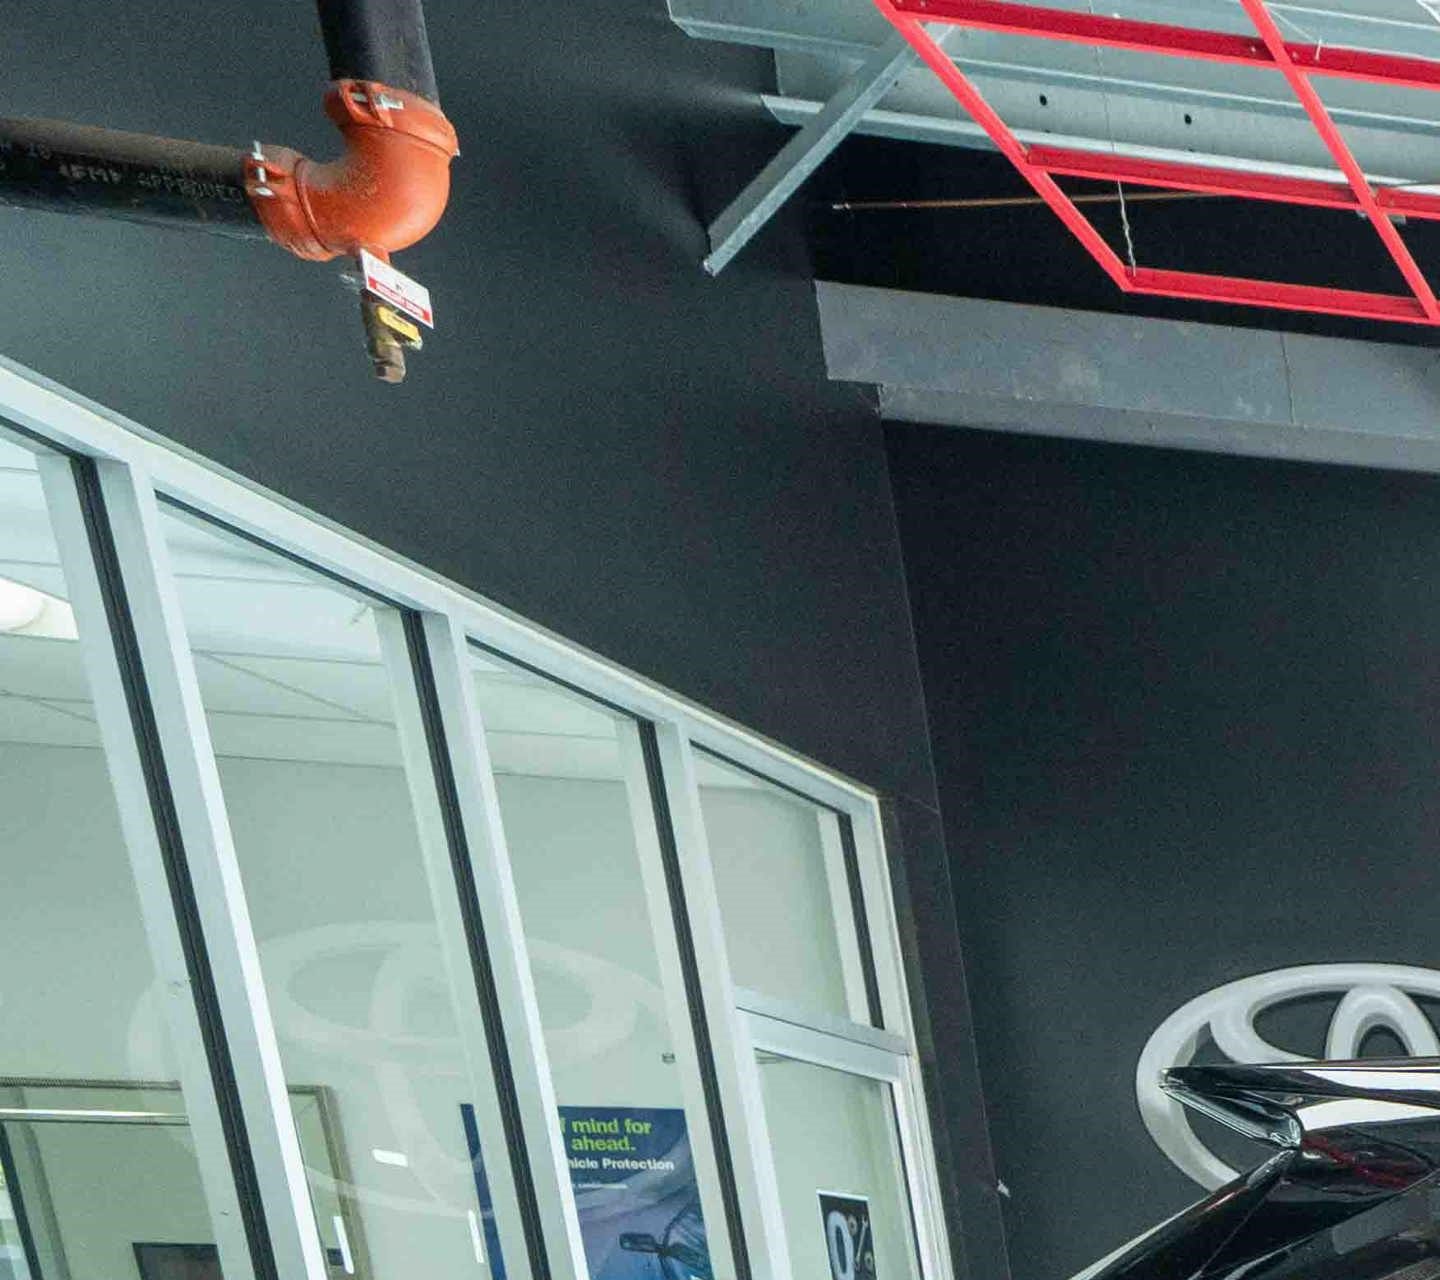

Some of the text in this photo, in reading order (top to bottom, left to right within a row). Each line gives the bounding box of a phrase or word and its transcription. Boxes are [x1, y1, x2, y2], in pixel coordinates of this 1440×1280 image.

[572, 1118, 618, 1134] mind
[624, 1118, 653, 1135] for
[572, 1136, 637, 1151] ahead.
[602, 1157, 675, 1171] Protection
